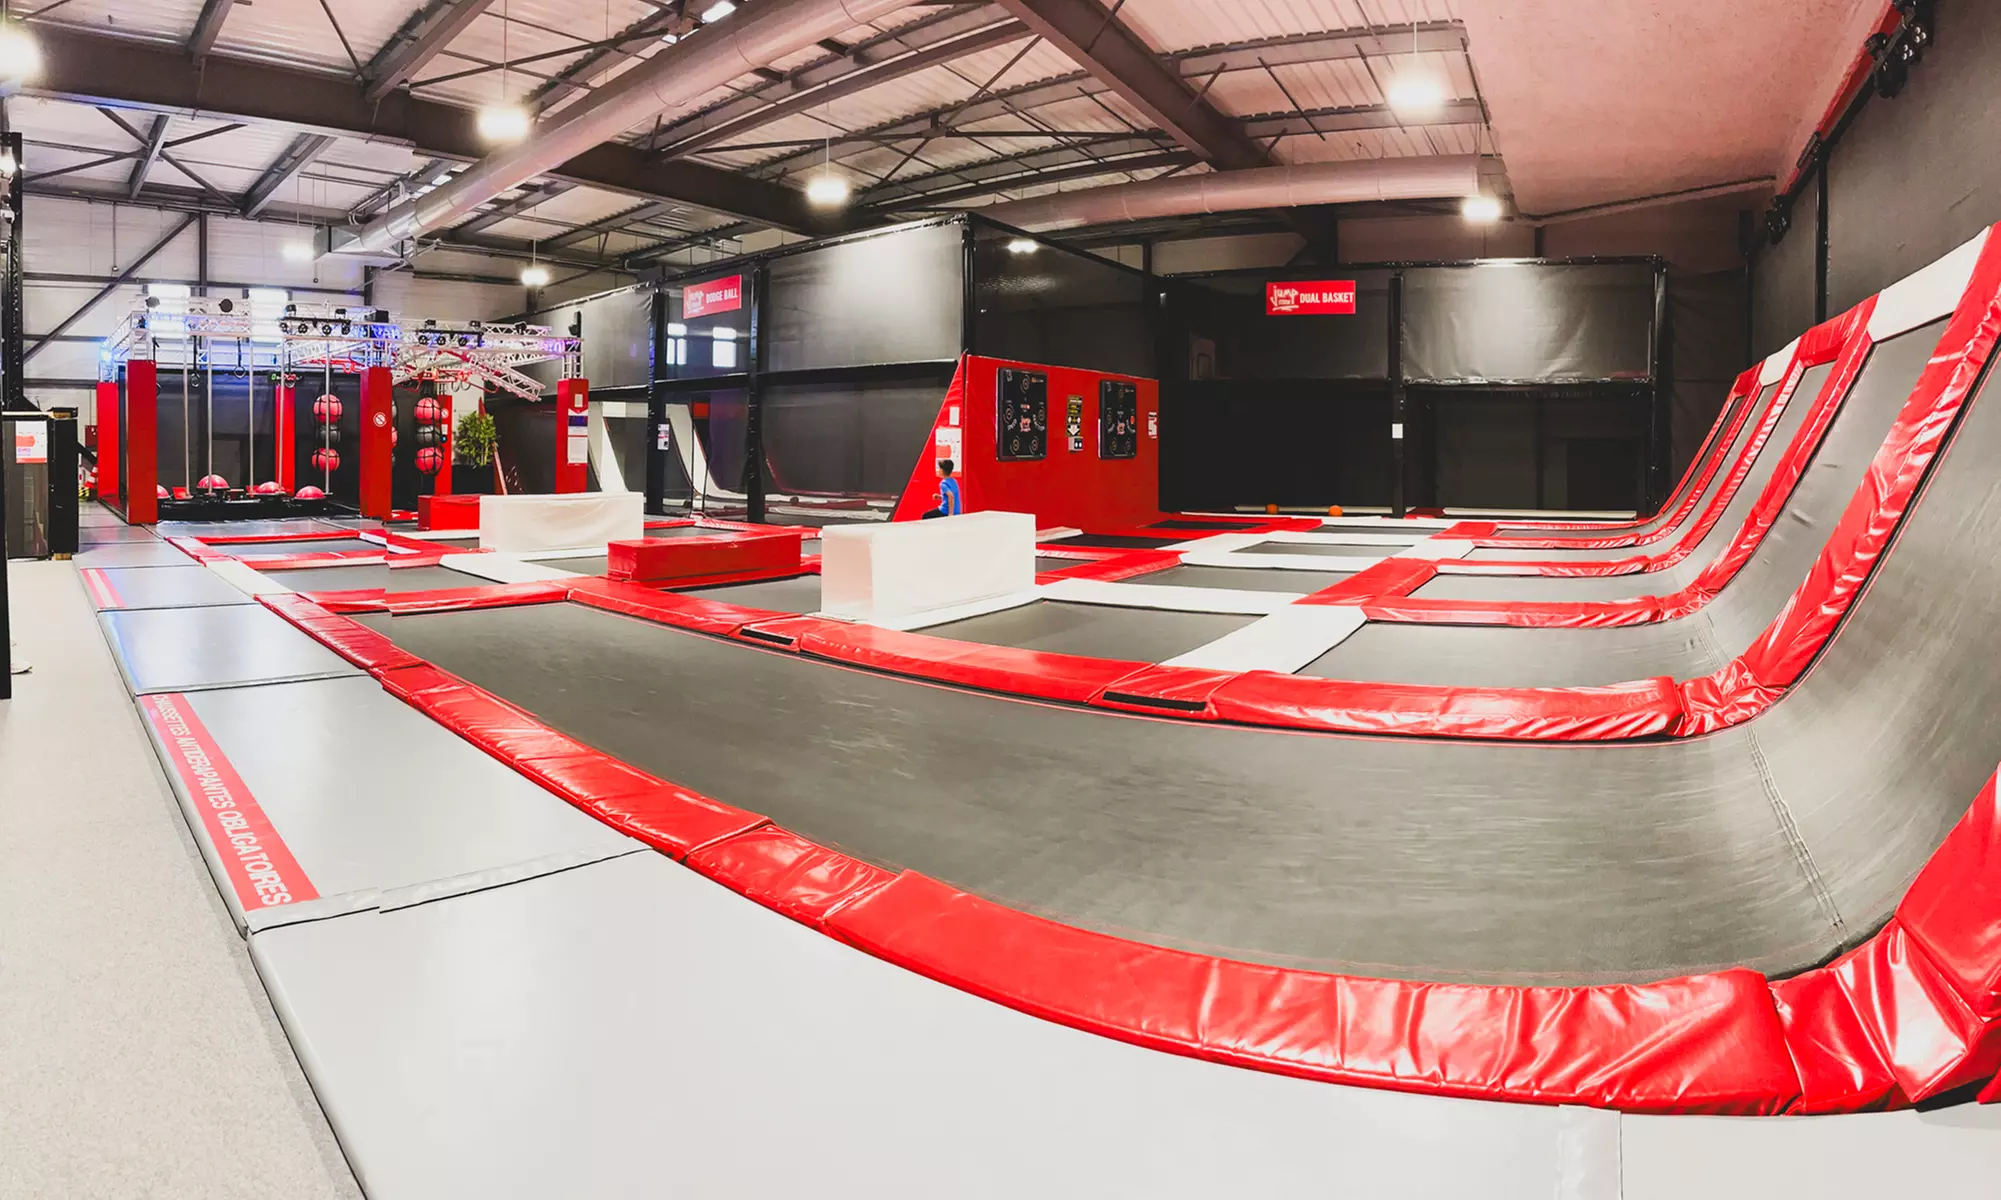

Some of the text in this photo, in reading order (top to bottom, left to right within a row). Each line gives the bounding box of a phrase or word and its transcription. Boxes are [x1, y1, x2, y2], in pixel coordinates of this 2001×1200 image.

[724, 288, 738, 300] BALL
[1300, 292, 1320, 304] DUAL
[1322, 291, 1354, 303] BASKET
[217, 811, 292, 905] OBLIGATOIRES
